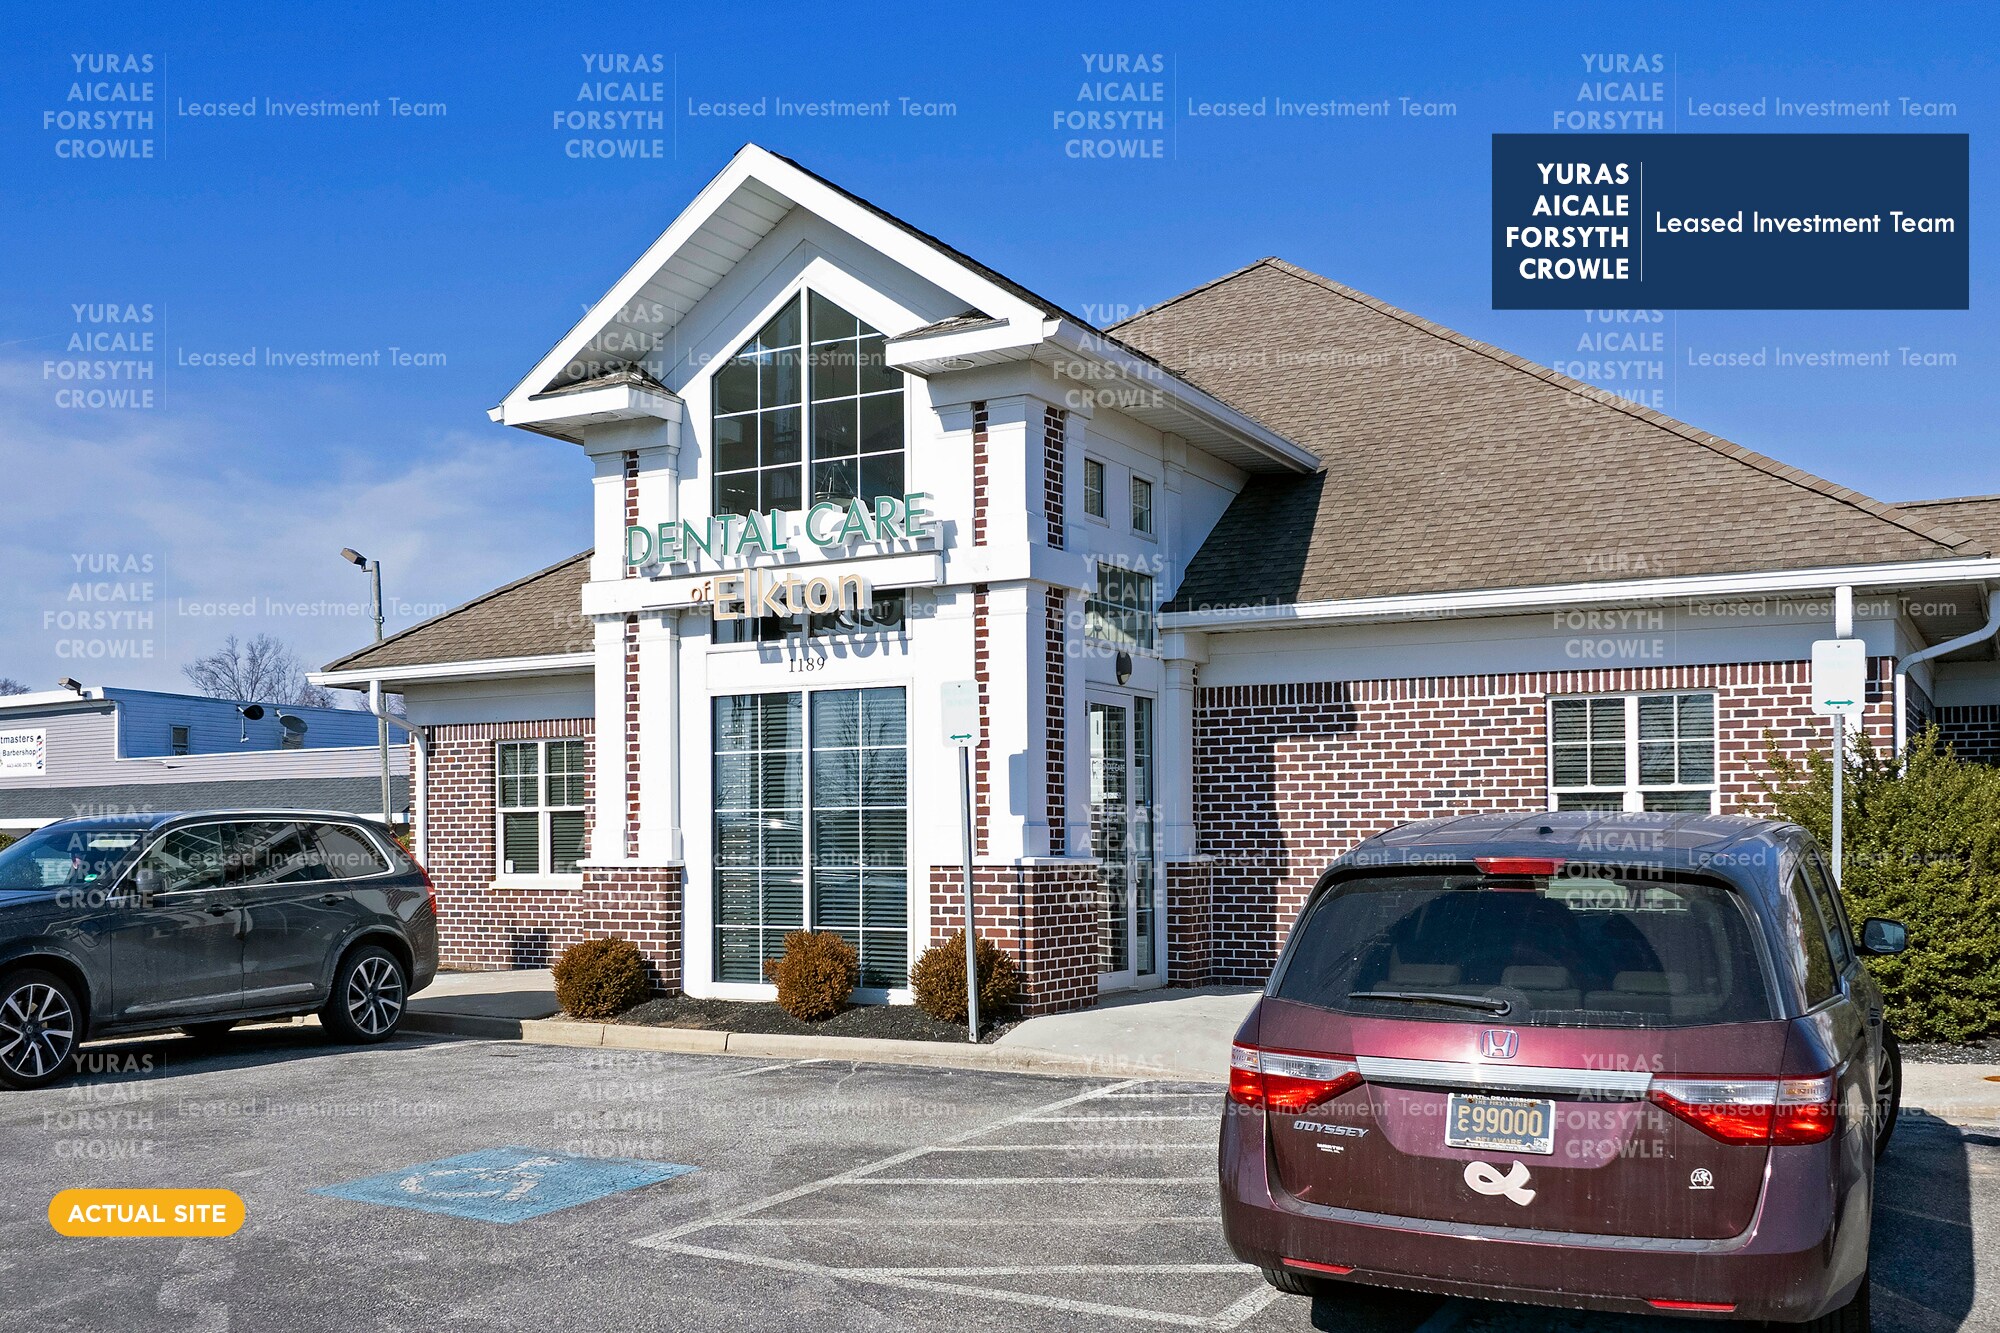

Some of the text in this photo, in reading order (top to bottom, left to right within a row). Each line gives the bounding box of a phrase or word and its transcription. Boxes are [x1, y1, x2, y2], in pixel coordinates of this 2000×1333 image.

[627, 492, 930, 567] DENTAL CARE
[691, 580, 710, 602] of
[713, 568, 868, 621] Elkton
[788, 656, 825, 673] 1189
[2, 749, 37, 757] Barbershop
[1293, 1120, 1369, 1138] ODYSSEY
[1472, 1106, 1543, 1137] 99000
